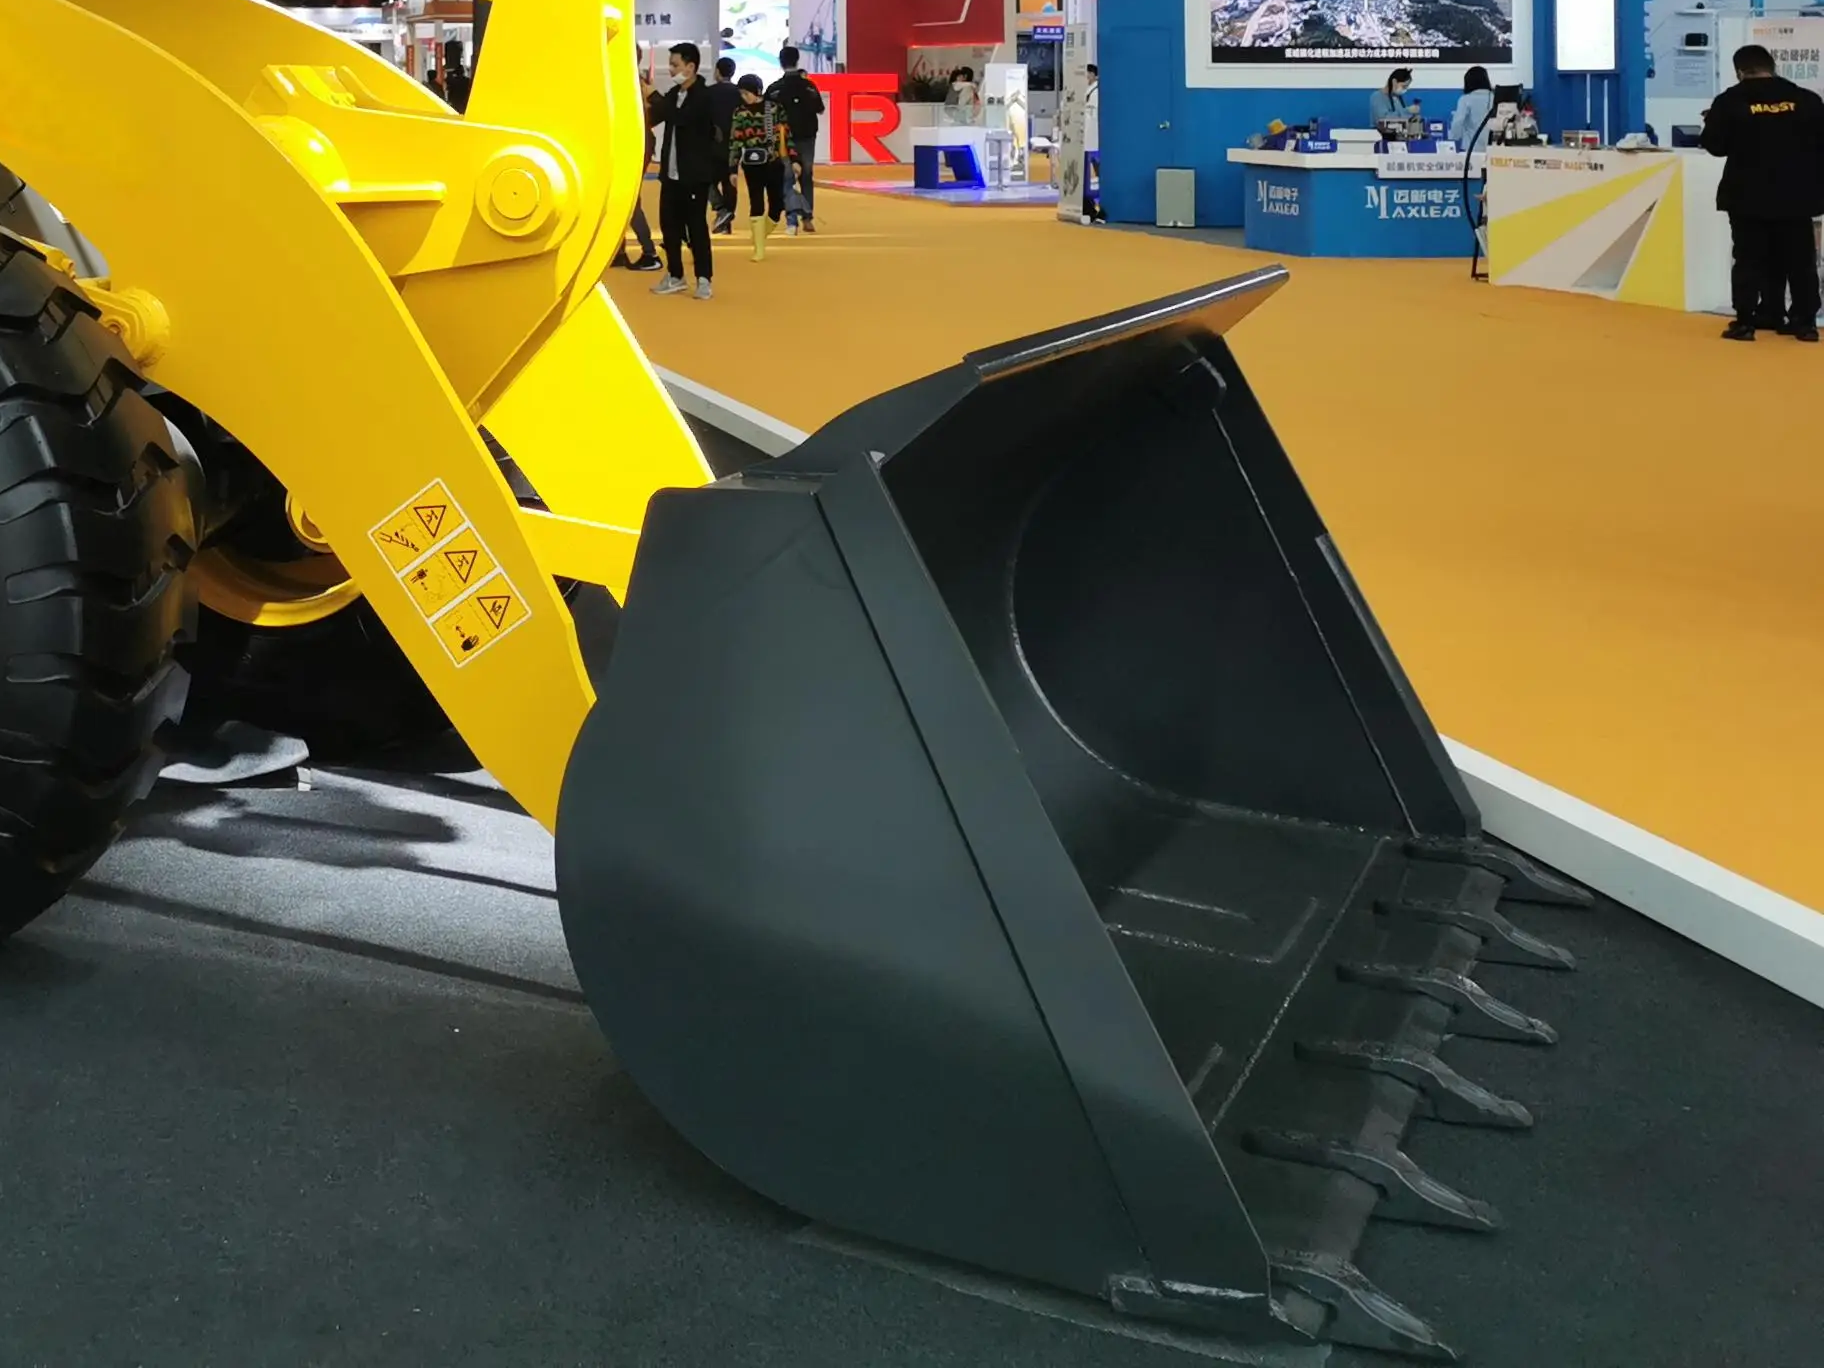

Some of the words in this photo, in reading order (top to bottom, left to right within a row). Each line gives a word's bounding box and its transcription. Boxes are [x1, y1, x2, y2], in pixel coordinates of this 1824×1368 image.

[1750, 102, 1796, 115] MASST
[1393, 188, 1460, 204] 迈新电子
